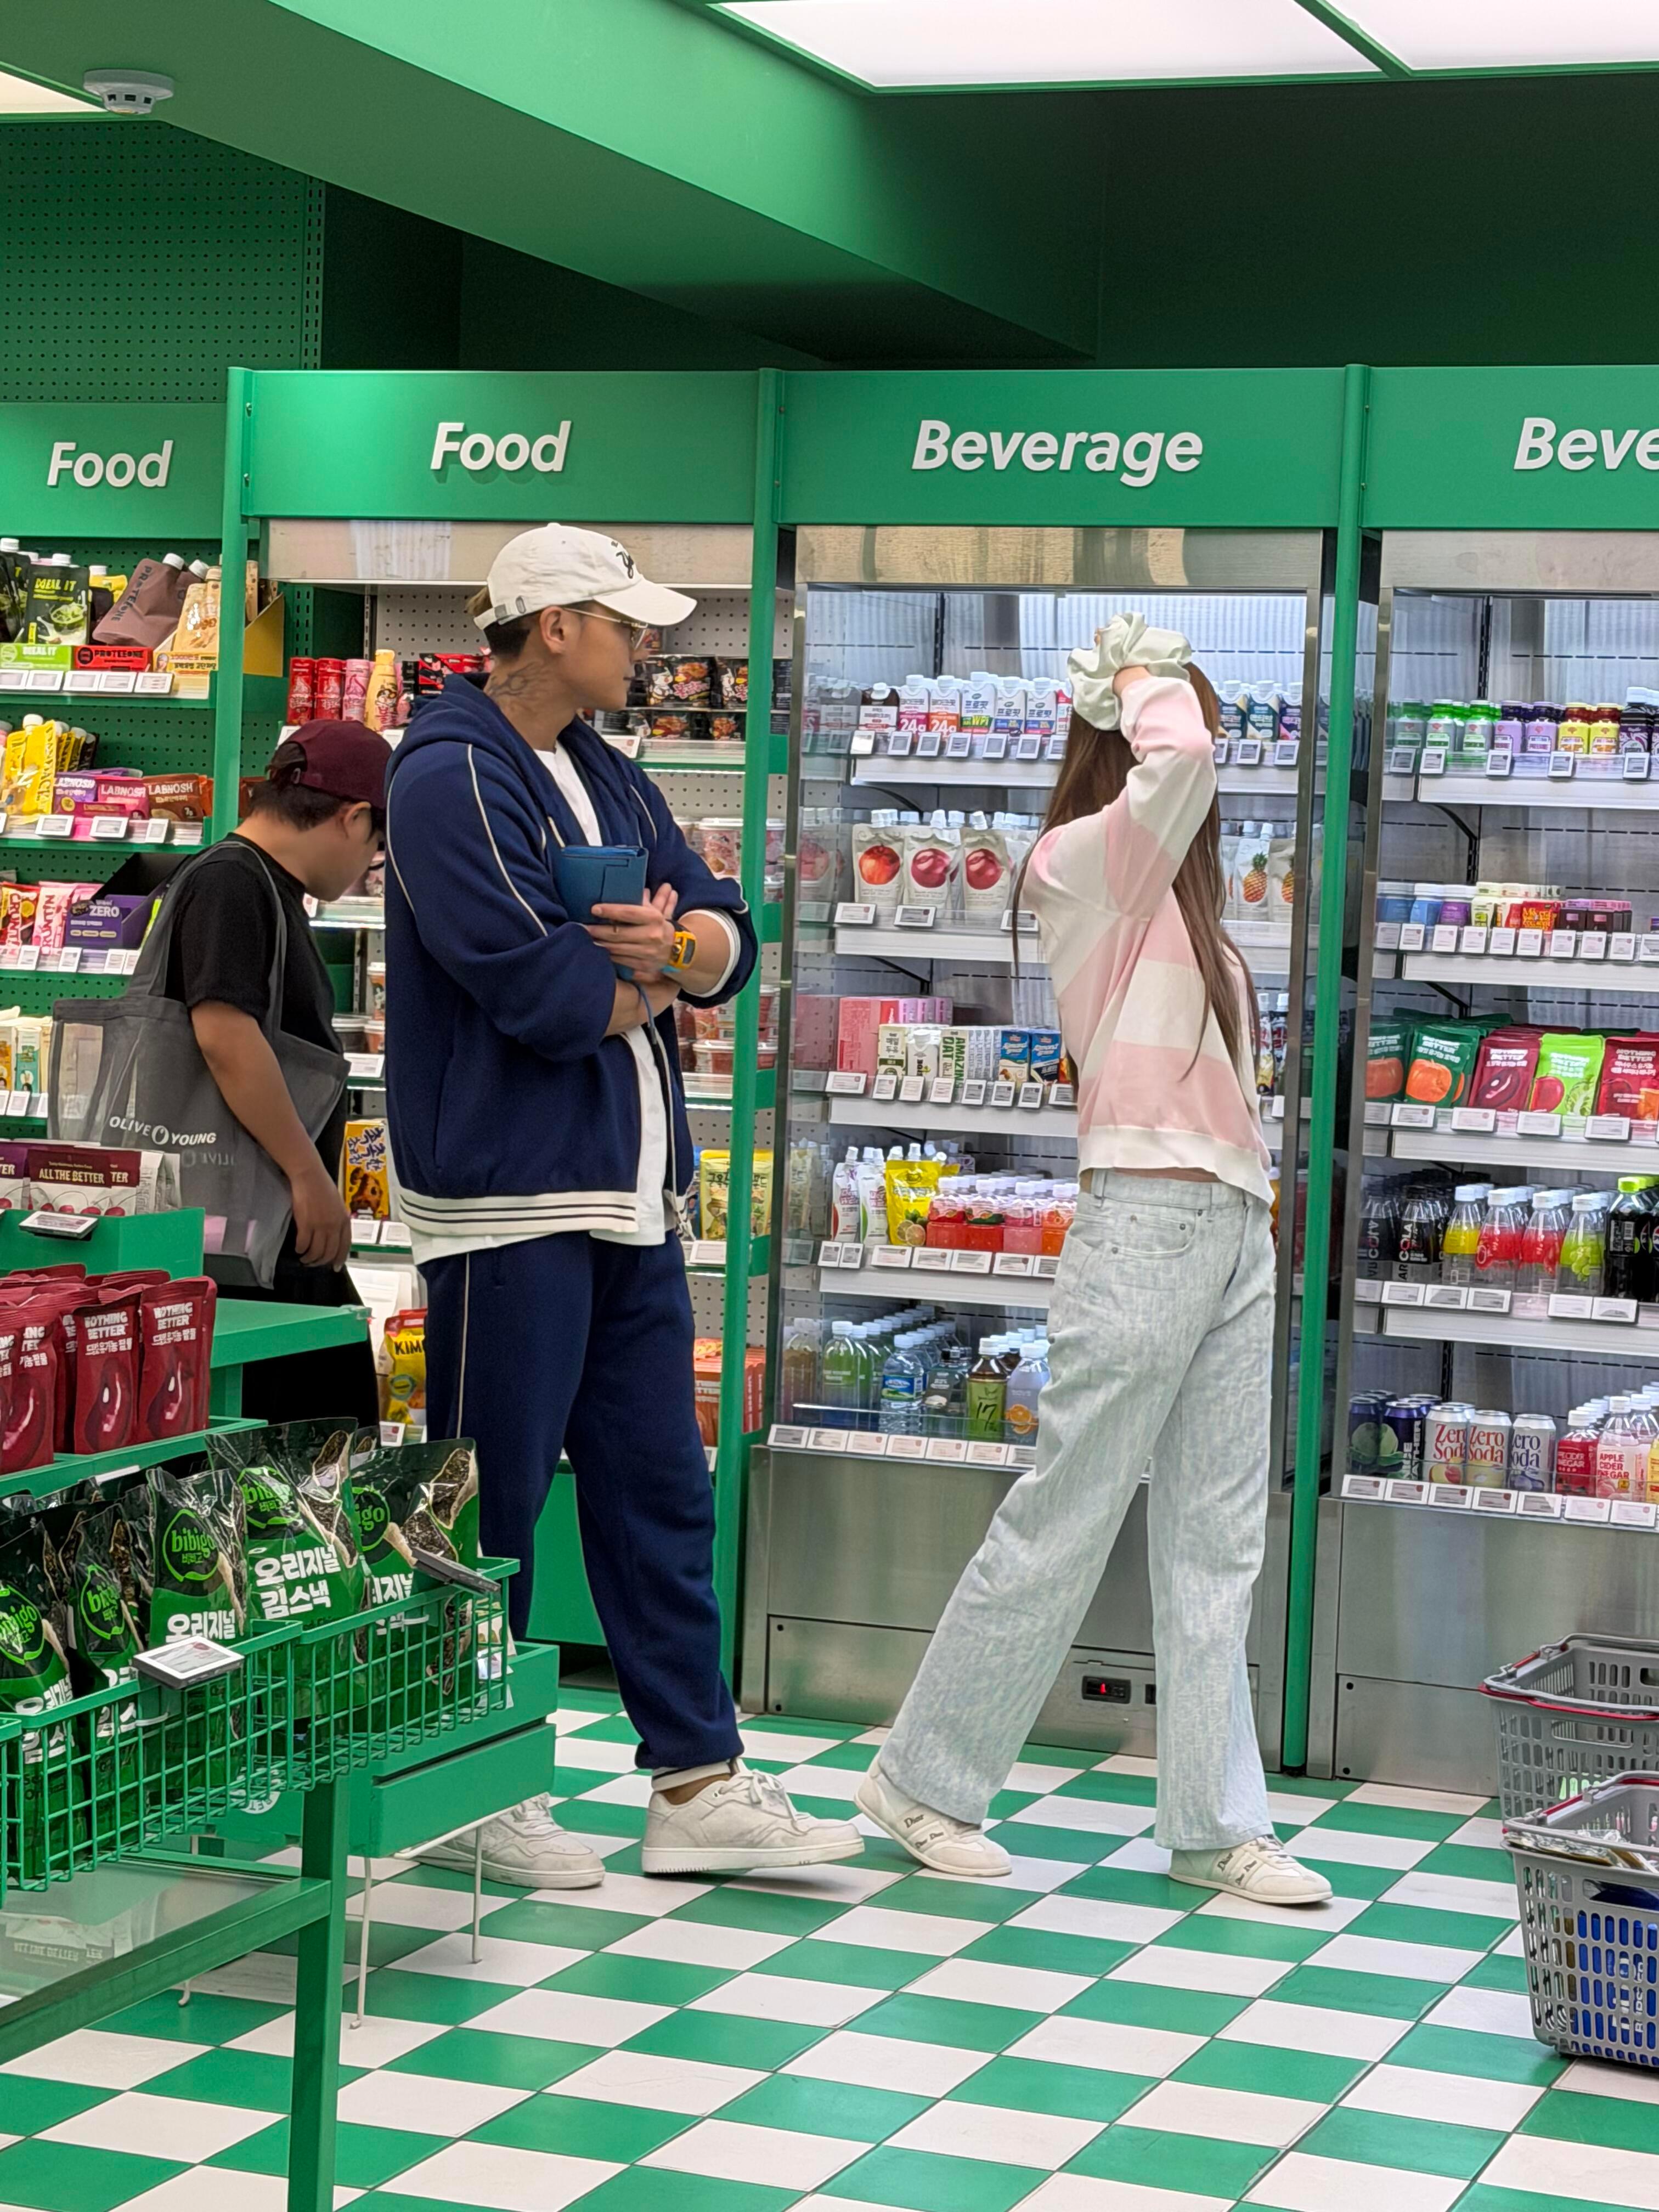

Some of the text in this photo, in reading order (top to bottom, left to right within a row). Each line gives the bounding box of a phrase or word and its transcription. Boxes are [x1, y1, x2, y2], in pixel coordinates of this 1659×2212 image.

[431, 421, 571, 471] Food
[912, 420, 1202, 486] Beverage
[1514, 418, 1659, 470] Beve
[48, 441, 172, 487] Food
[64, 580, 77, 592] IT
[101, 784, 146, 798] LABNOSH
[148, 782, 193, 795] LABNOSH
[89, 905, 120, 917] ZERO
[110, 1116, 151, 1137] OLIVE
[171, 1132, 217, 1146] YOUNG
[39, 1168, 105, 1184] ALL THE BETTER
[1400, 1223, 1413, 1261] COLA
[154, 1301, 193, 1319] NOTHING
[84, 1311, 128, 1328] NOTHING
[157, 1314, 190, 1330] BETTER
[88, 1324, 126, 1340] BETTER
[1511, 1449, 1540, 1468] oda
[1599, 1462, 1623, 1471] CIDER
[1600, 1453, 1624, 1462] APPLE
[172, 1527, 215, 1558] bibigo
[255, 1544, 341, 1587] 오리지널
[261, 1579, 331, 1620] 김스낵
